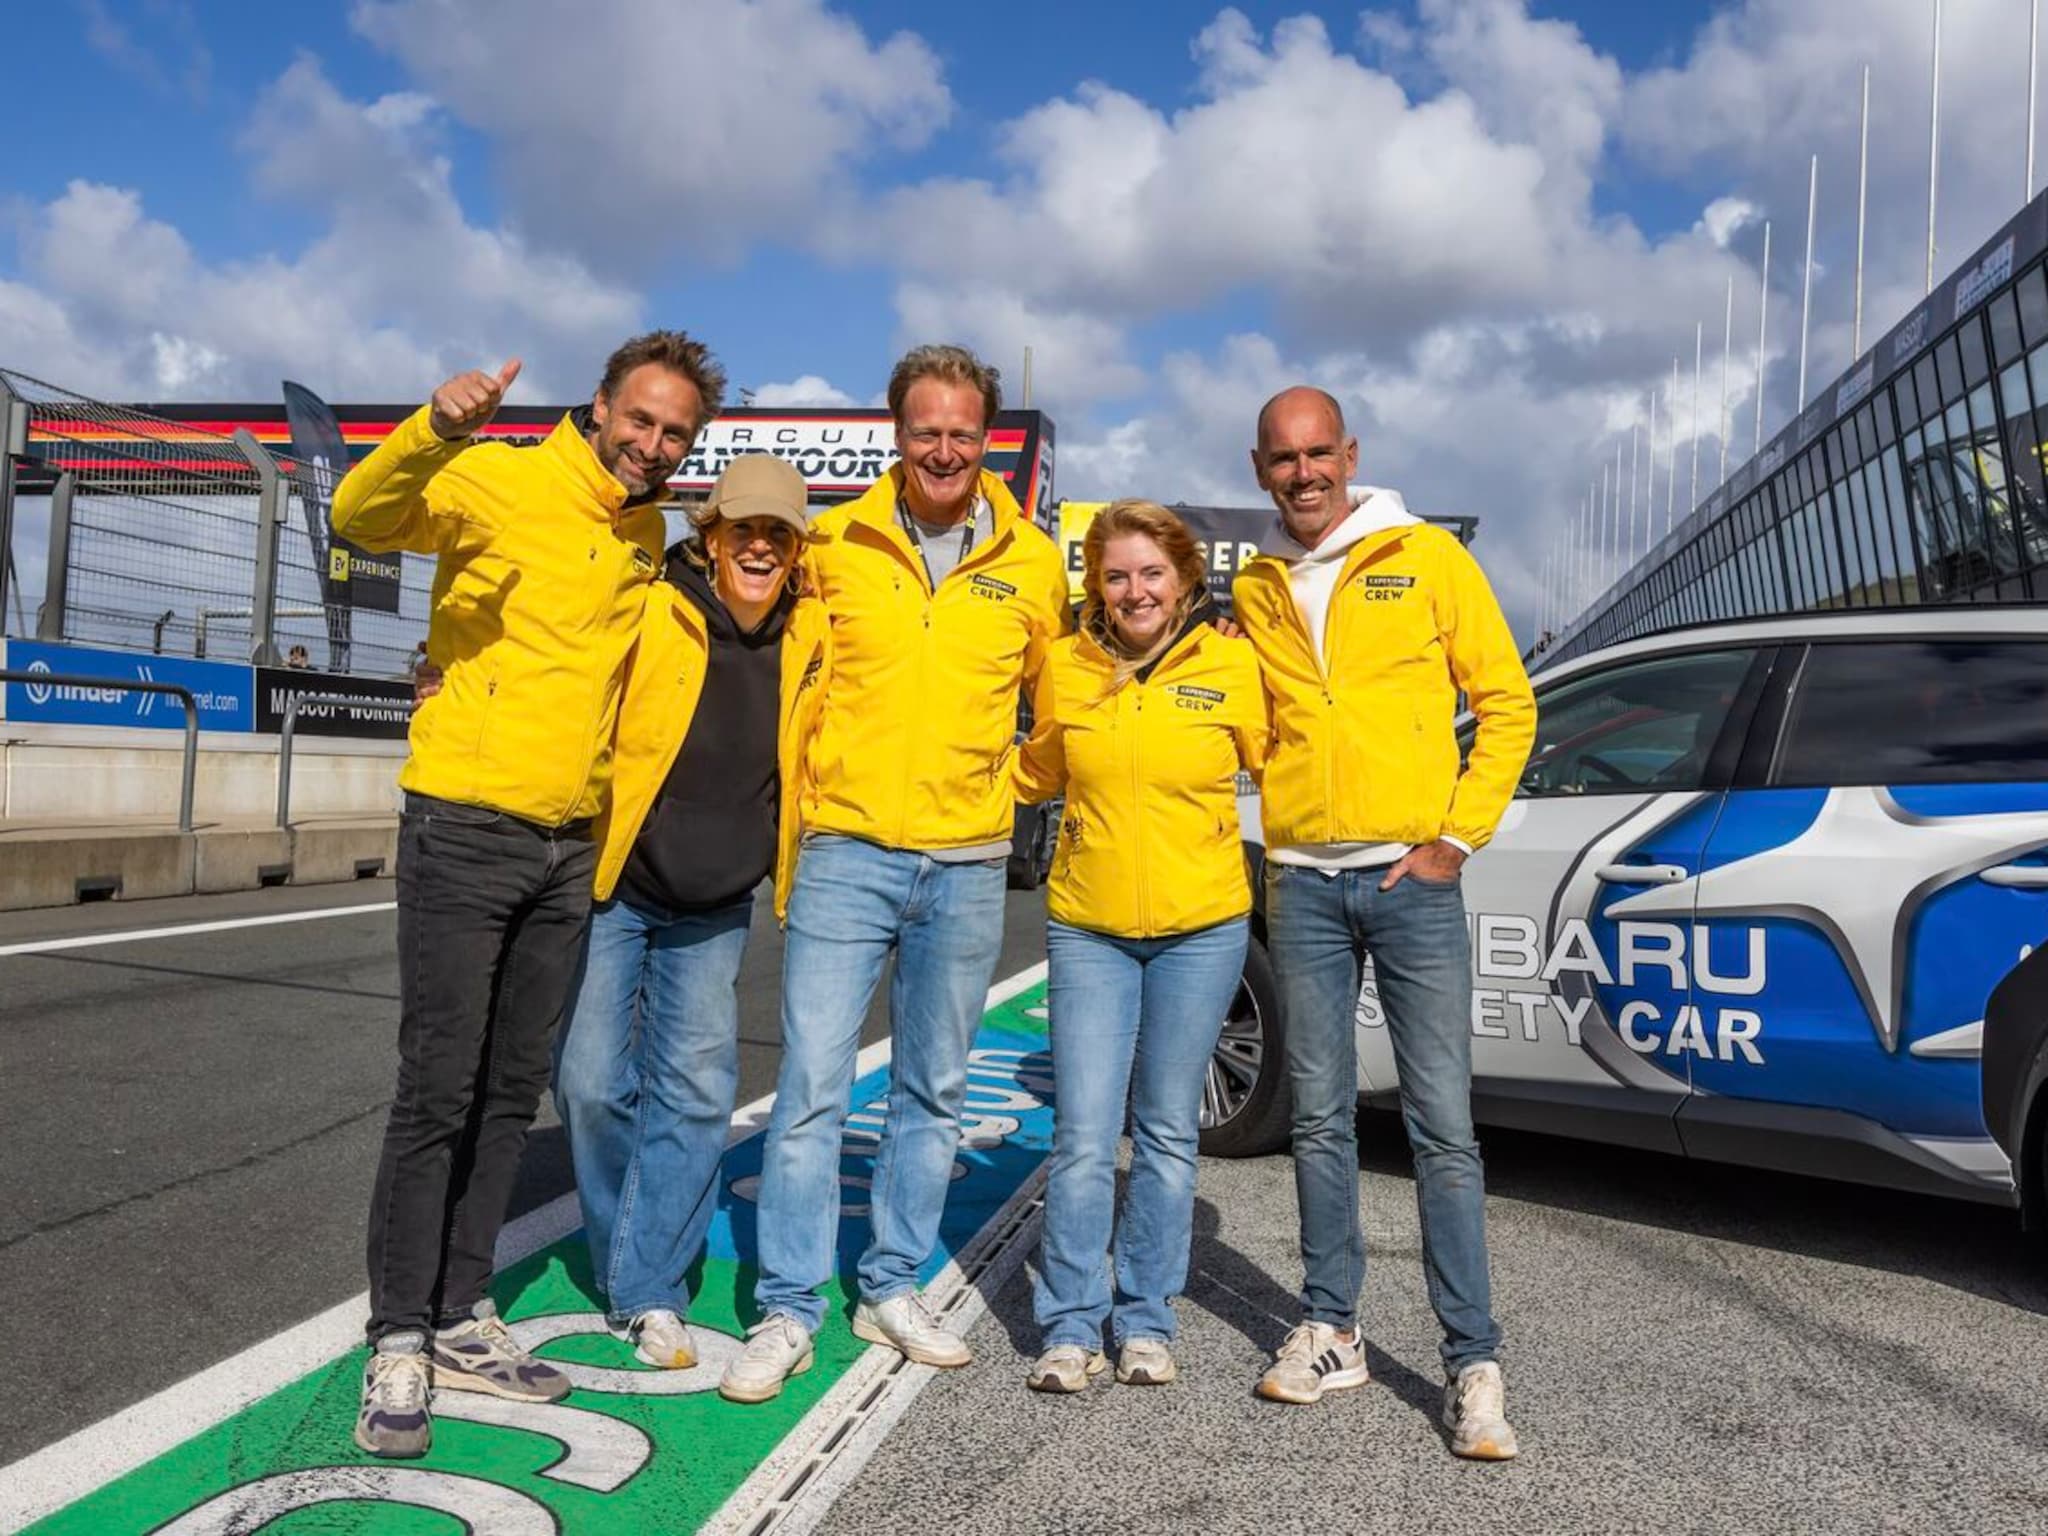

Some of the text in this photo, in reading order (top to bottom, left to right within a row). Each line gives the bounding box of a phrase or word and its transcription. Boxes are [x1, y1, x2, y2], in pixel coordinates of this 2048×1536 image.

[702, 428, 874, 444] IRCUI
[970, 586, 1007, 602] CREW
[1364, 590, 1404, 601] CREW
[1175, 698, 1214, 712] CREW
[1464, 913, 1767, 996] BARU
[1355, 985, 1766, 1065] SETY CAR
